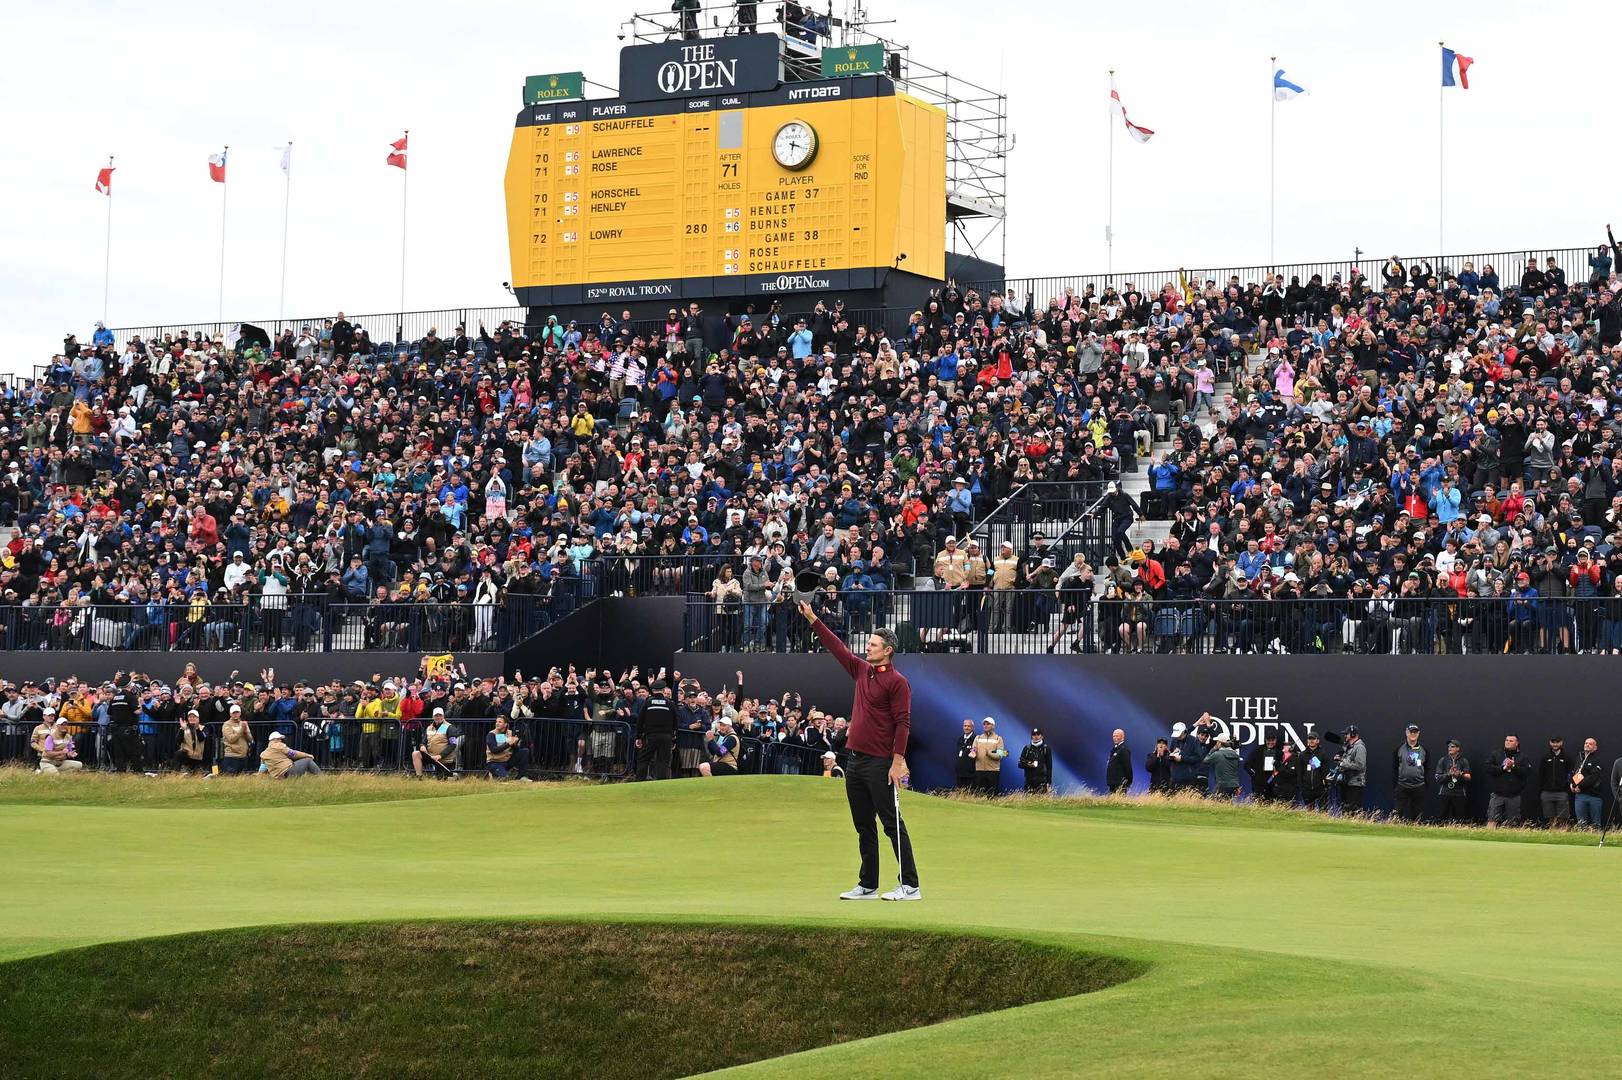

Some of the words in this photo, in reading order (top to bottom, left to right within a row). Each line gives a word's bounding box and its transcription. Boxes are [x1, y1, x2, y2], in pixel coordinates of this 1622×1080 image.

[681, 44, 715, 62] THE
[834, 61, 870, 73] ROLEX
[657, 59, 738, 93] OPEN
[537, 88, 569, 98] ROLEX
[789, 88, 811, 99] NTT
[535, 113, 552, 121] HOLE
[563, 111, 577, 119] PAR
[592, 104, 627, 116] PLAYER
[688, 100, 710, 108] SCORE
[536, 127, 550, 137] 72
[592, 118, 655, 132] SCHAUFFELE
[535, 153, 549, 164] 70
[567, 151, 579, 161] -6
[592, 146, 642, 159] LAWRENCE
[719, 153, 742, 161] AFTER
[853, 154, 870, 162] SCORE
[535, 167, 548, 177] 71
[592, 162, 617, 173] ROSE
[721, 163, 737, 178] 71
[854, 171, 869, 180] RND
[718, 182, 741, 191] HOLES
[779, 175, 815, 187] PLAYER
[534, 193, 548, 204] 70
[566, 191, 579, 202] -5
[591, 187, 641, 200] HORSCHEL
[765, 190, 796, 202] GAME
[805, 188, 820, 199] 37
[534, 207, 546, 217] 71
[566, 205, 578, 215] -5
[591, 202, 627, 213] HENLEY
[727, 207, 740, 218] -5
[750, 204, 796, 217] HENLEY
[726, 221, 740, 232] +6
[750, 219, 788, 231] BURNS
[533, 234, 547, 244] 72
[590, 229, 623, 241] LOWRY
[686, 223, 708, 235] 280
[765, 232, 795, 243] GAME
[804, 230, 819, 241] 38
[726, 249, 739, 260] -6
[749, 247, 779, 258] ROSE
[726, 263, 739, 273] -9
[749, 258, 827, 272] SCHAUFFELE
[609, 286, 638, 297] ROYAL
[639, 284, 672, 295] TROON
[1225, 696, 1279, 720] THE
